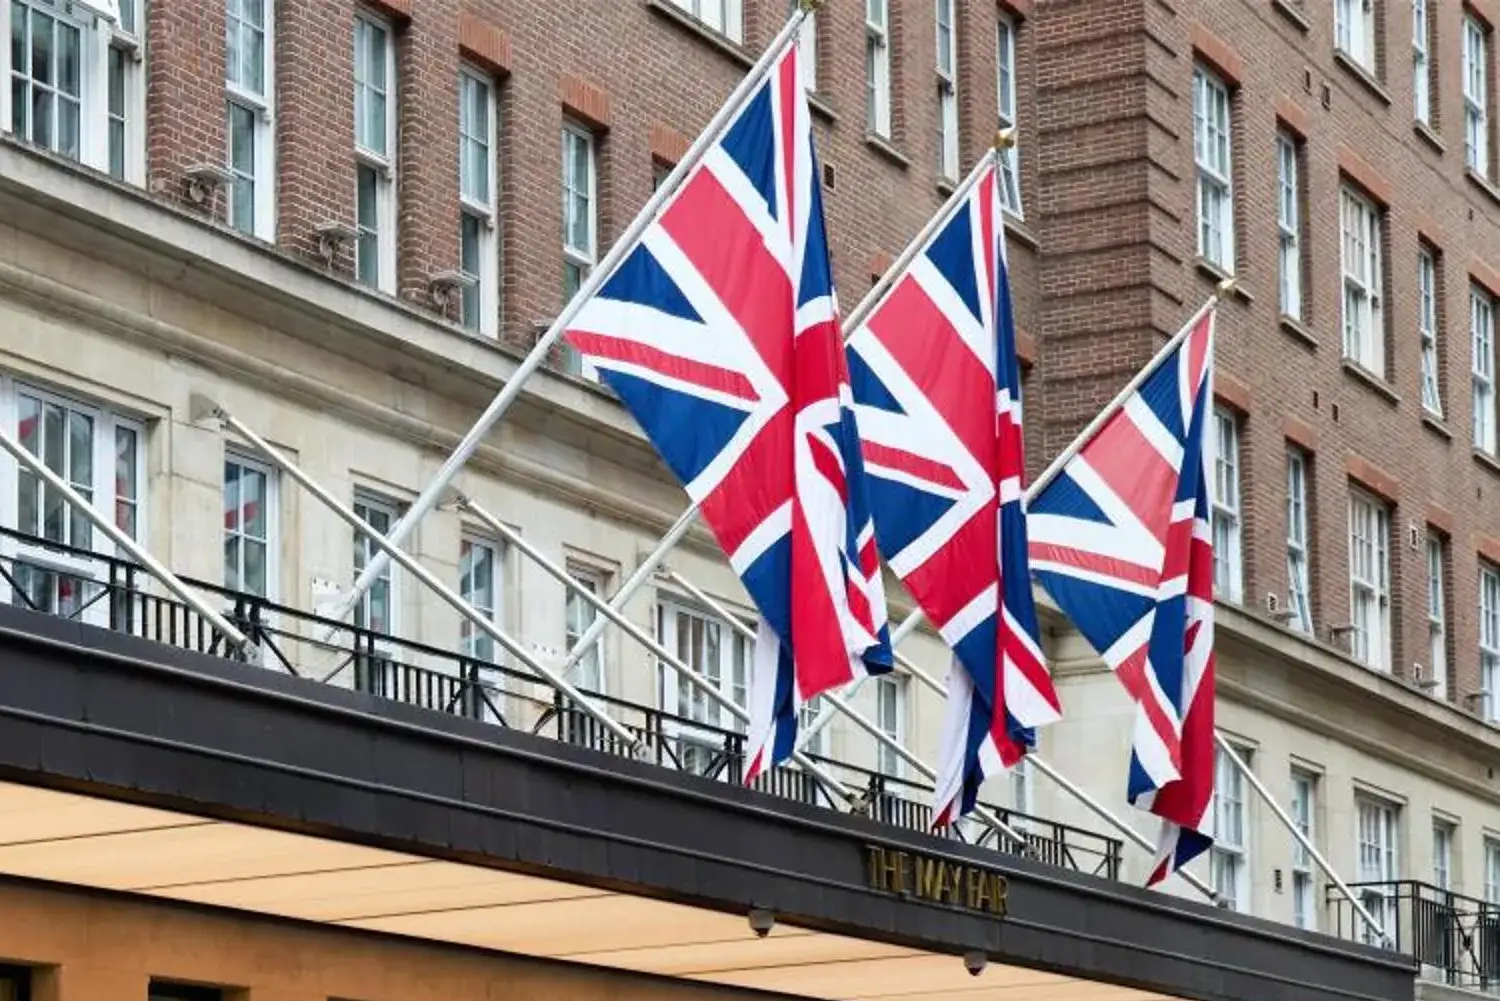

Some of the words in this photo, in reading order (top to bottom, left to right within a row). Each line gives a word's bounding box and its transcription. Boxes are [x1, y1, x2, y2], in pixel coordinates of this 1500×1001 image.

[866, 845, 911, 897] THE
[915, 856, 963, 906] MAY
[967, 868, 1009, 918] FAIR
